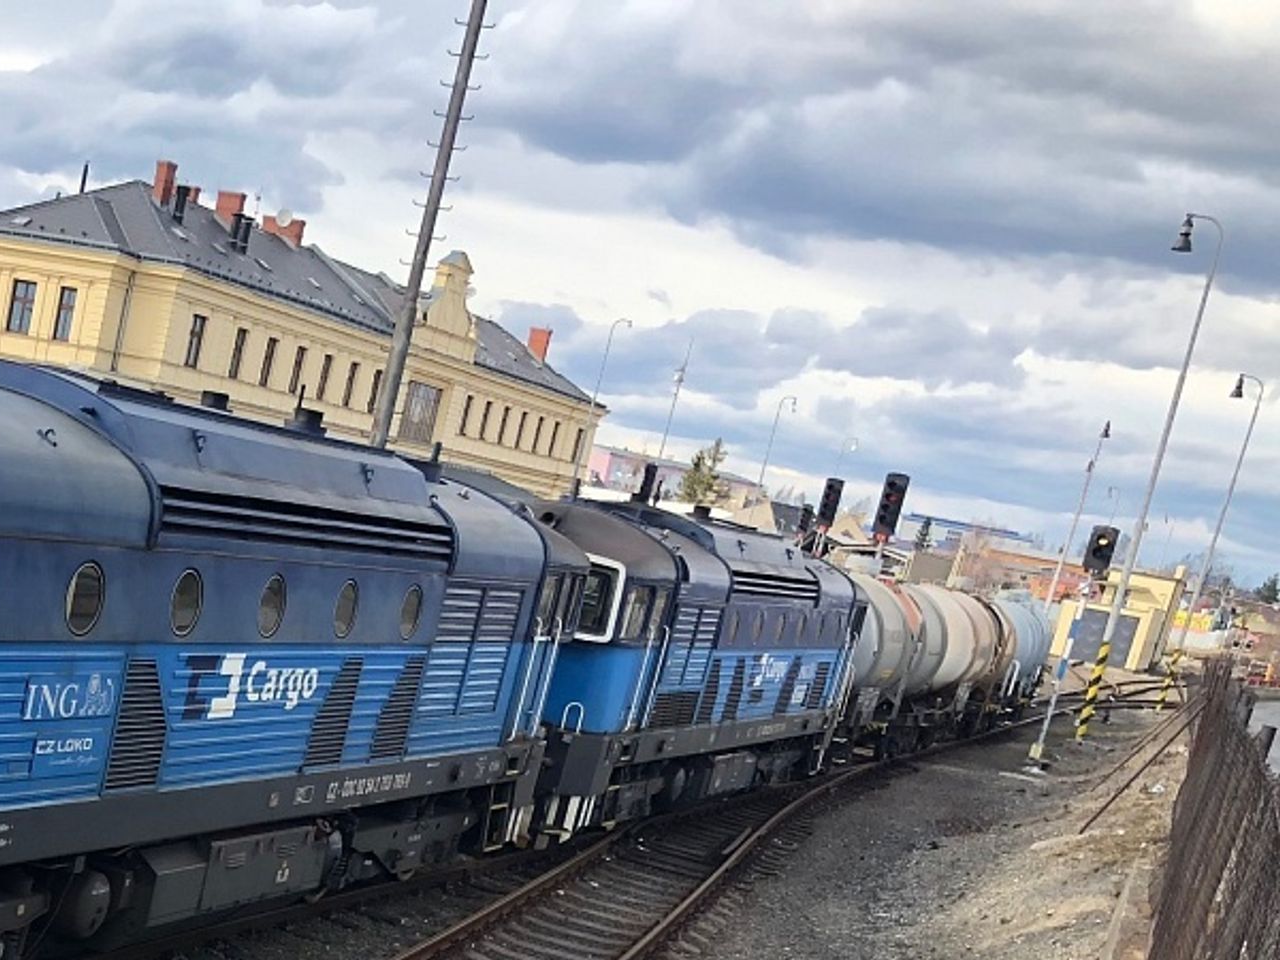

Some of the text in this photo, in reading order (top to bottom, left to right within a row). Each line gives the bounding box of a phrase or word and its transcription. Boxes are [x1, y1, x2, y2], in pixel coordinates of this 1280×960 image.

[23, 682, 79, 720] ING
[246, 660, 319, 710] Cargo
[35, 739, 56, 755] CZ
